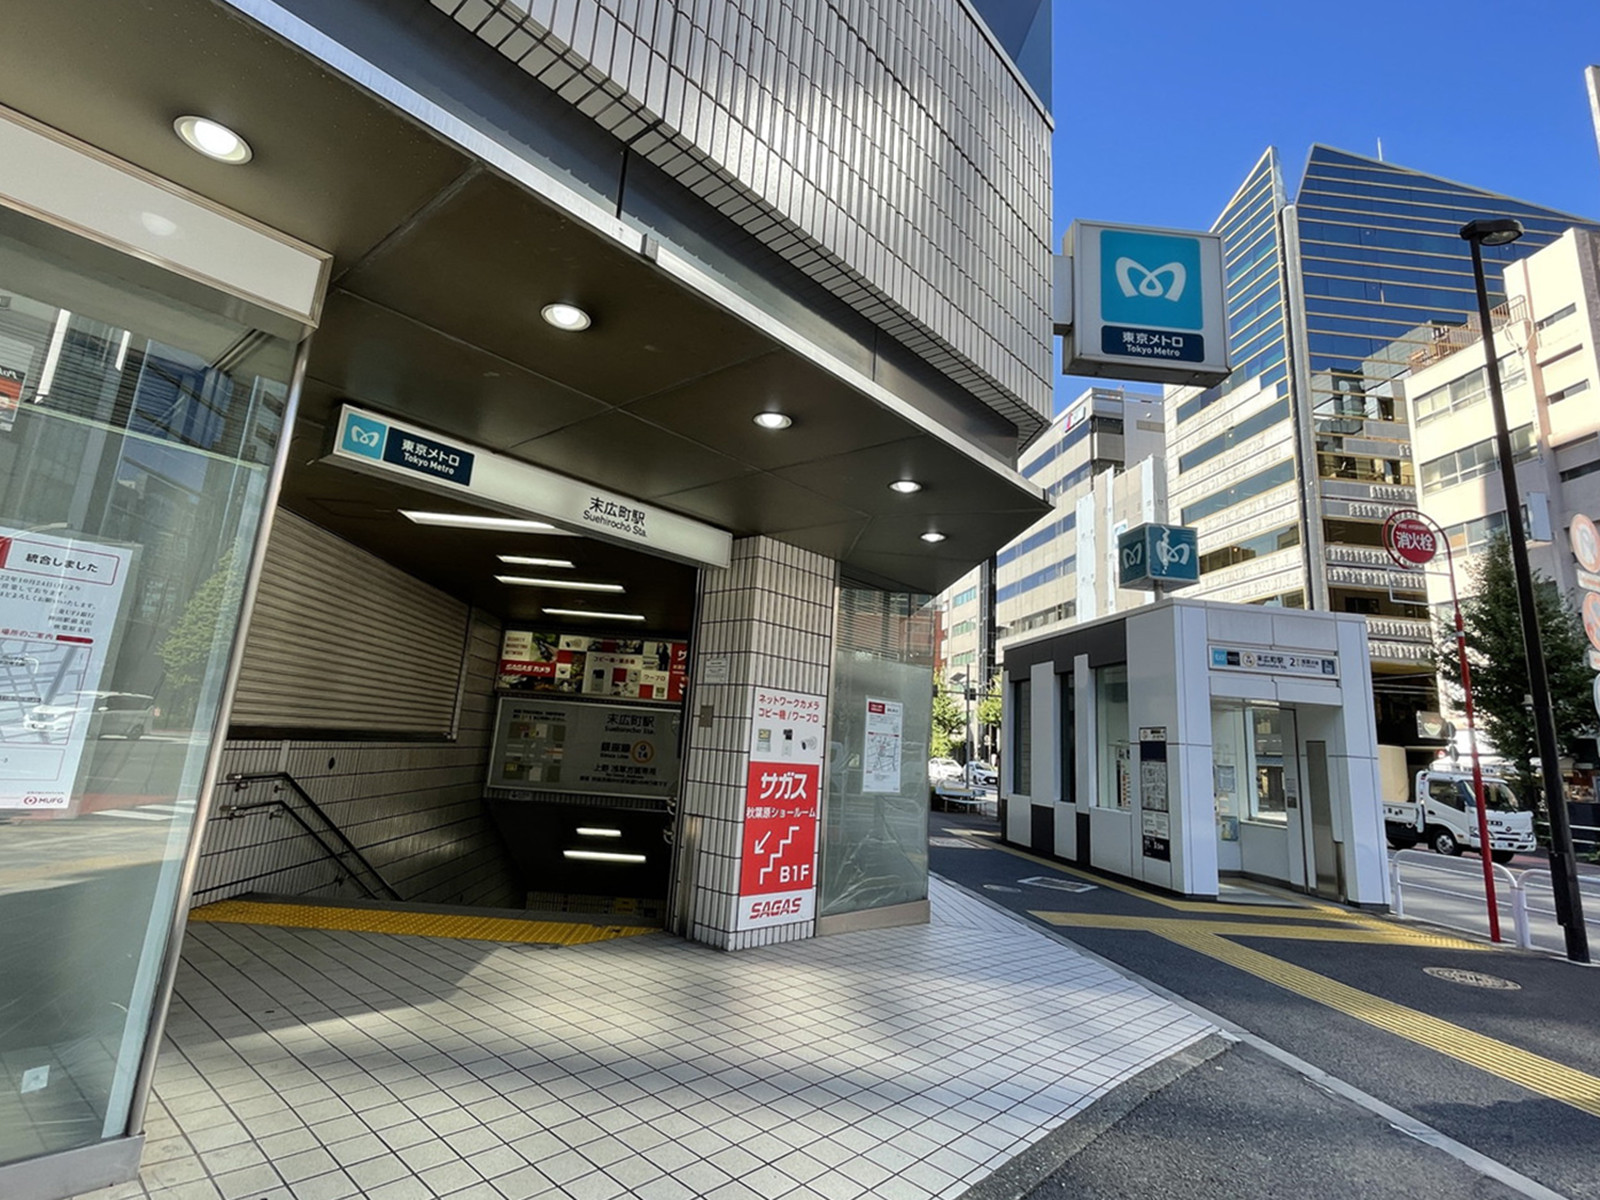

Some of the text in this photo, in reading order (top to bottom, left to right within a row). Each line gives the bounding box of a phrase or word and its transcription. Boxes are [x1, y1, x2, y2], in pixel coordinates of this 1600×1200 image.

[1122, 331, 1183, 347] 東京メトロ
[1126, 344, 1180, 357] Tokyo Metro
[401, 439, 460, 467] 東京メトロ
[403, 452, 455, 475] Tokyo Metro
[589, 496, 646, 526] 末広町駅
[1395, 531, 1434, 552] 消火栓
[25, 553, 99, 573] 統合しました
[1289, 657, 1296, 667] 2
[759, 694, 820, 710] ネットワークカメラ
[607, 713, 655, 727] 末広町駅
[760, 772, 808, 800] サガス
[38, 797, 63, 805] MUFG
[746, 806, 816, 819] 秋葉原ショールーム
[780, 864, 809, 883] B1F
[749, 897, 802, 920] SAGAS
